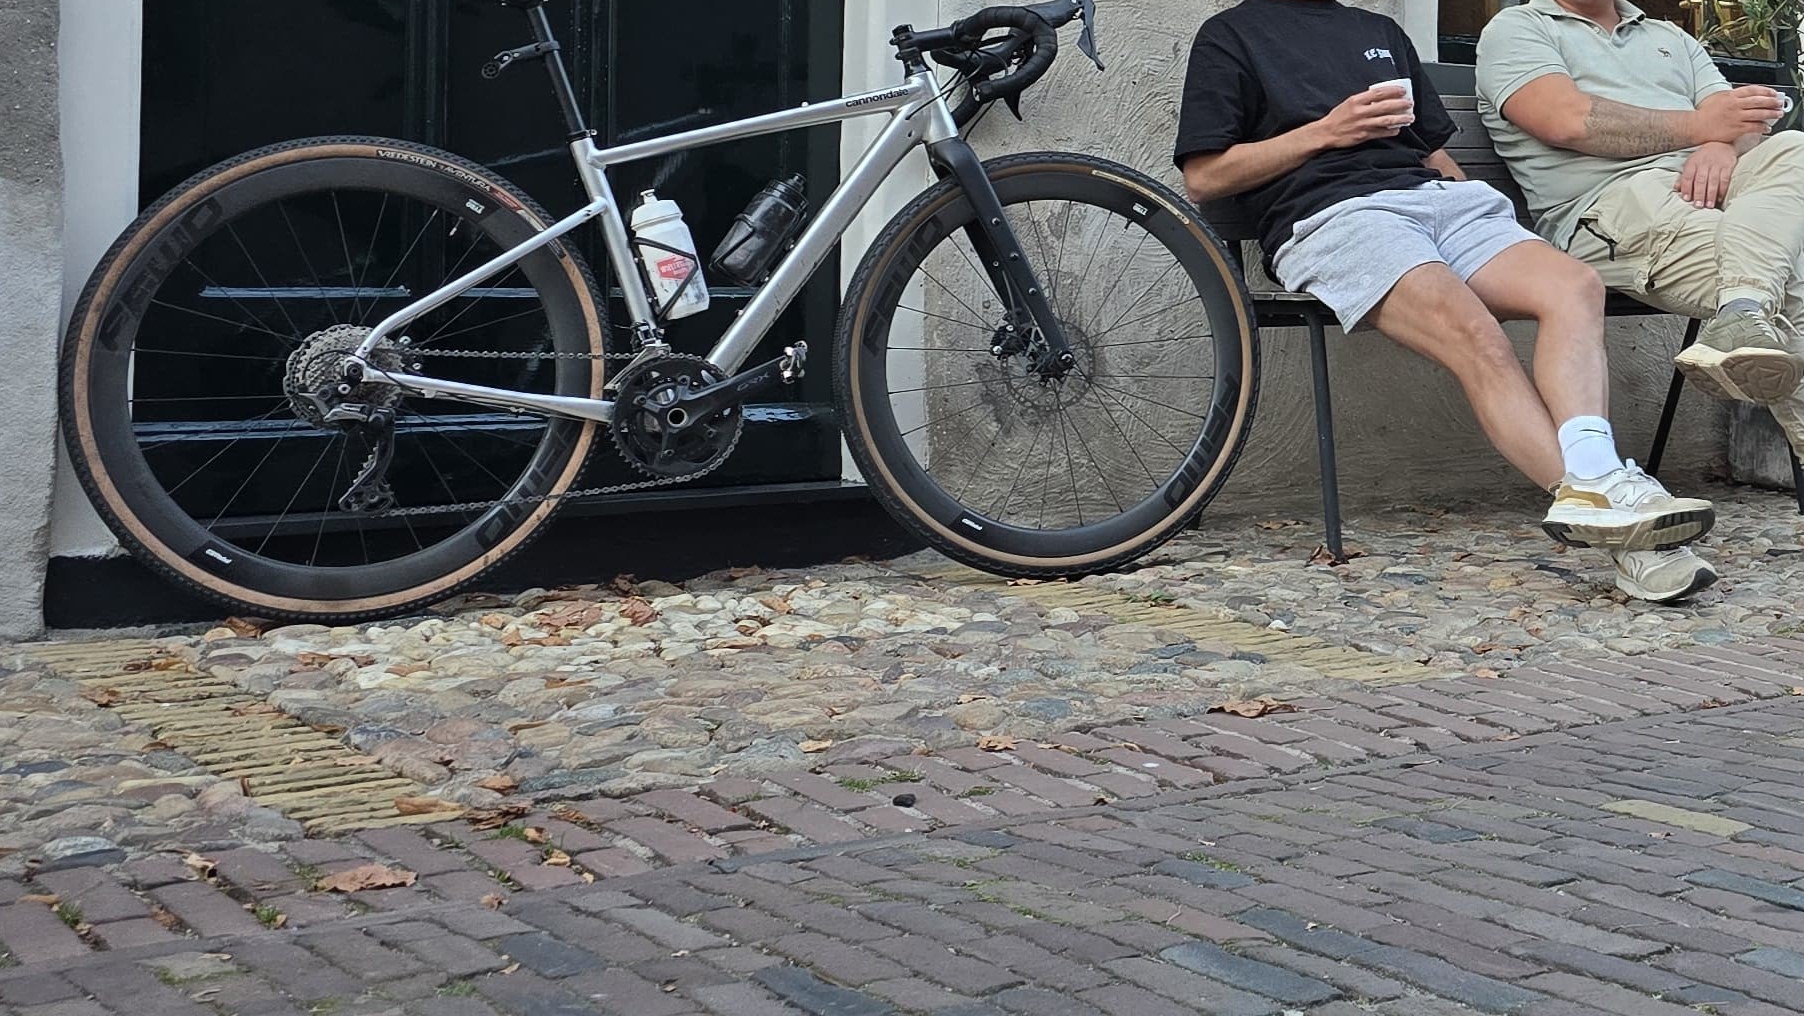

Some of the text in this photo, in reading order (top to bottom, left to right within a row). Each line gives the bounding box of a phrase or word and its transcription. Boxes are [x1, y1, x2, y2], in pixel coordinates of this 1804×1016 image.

[845, 88, 909, 108] cannondale
[377, 149, 491, 192] VREDESTEIN AVENTURA
